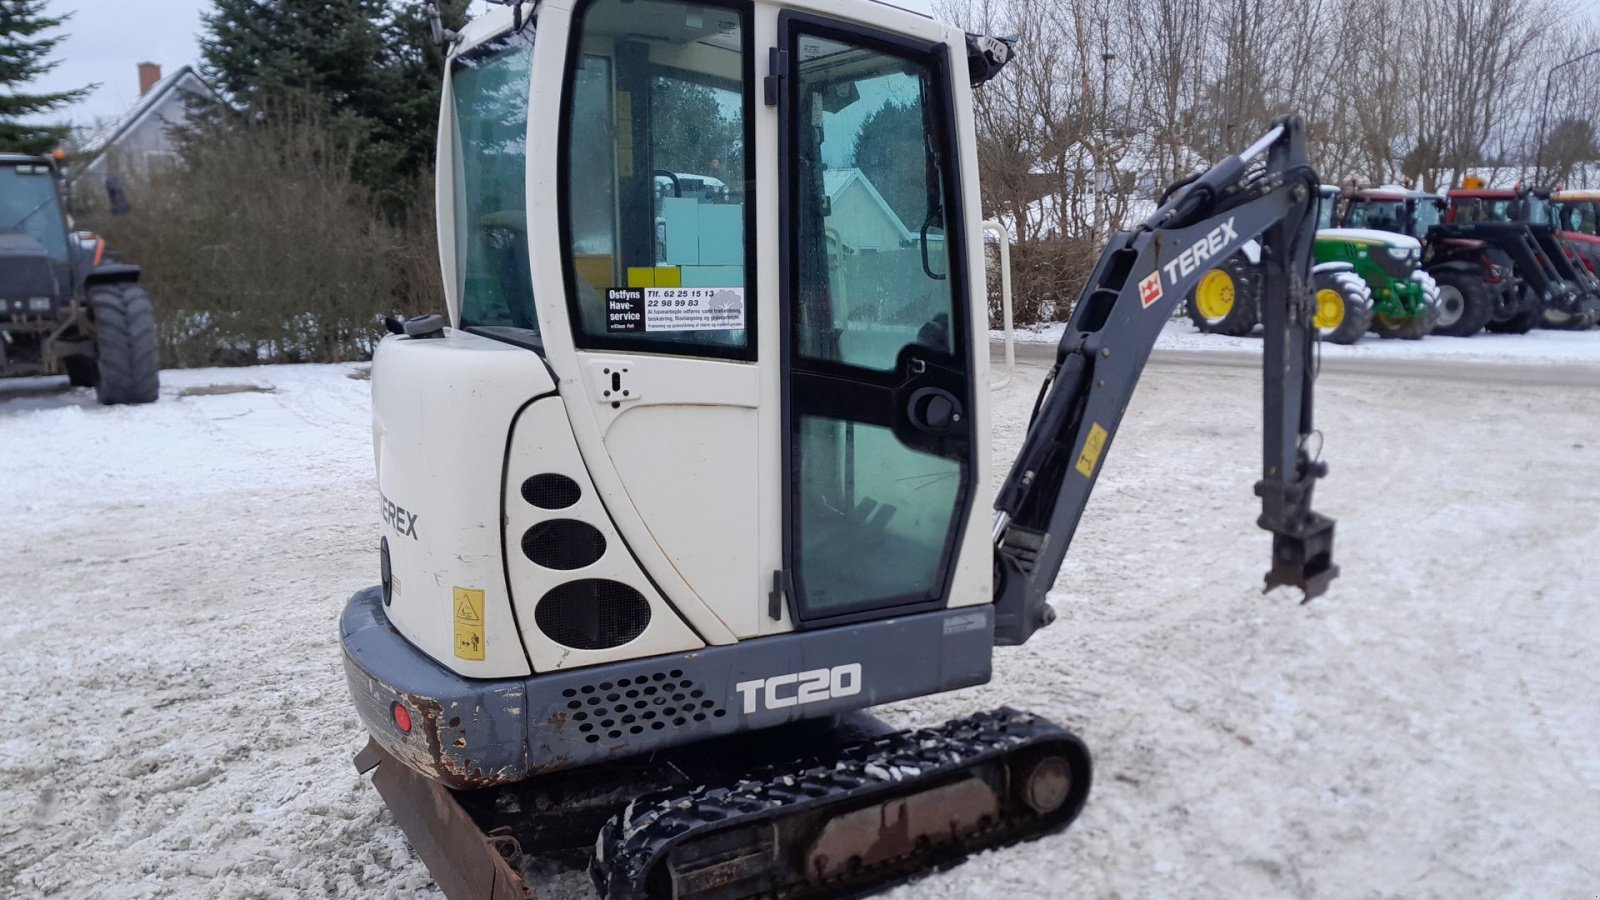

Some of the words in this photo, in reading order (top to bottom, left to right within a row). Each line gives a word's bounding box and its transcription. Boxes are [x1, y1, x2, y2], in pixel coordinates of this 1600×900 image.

[1163, 216, 1238, 285] TEREX
[609, 289, 640, 301] Østfyns
[648, 290, 661, 298] Tlf.
[664, 290, 675, 298] 62
[677, 290, 688, 298] 25
[691, 290, 701, 298] 15
[610, 301, 634, 310] Have-
[688, 299, 699, 307] 83
[610, 311, 640, 321] service
[736, 663, 862, 714] TC20
